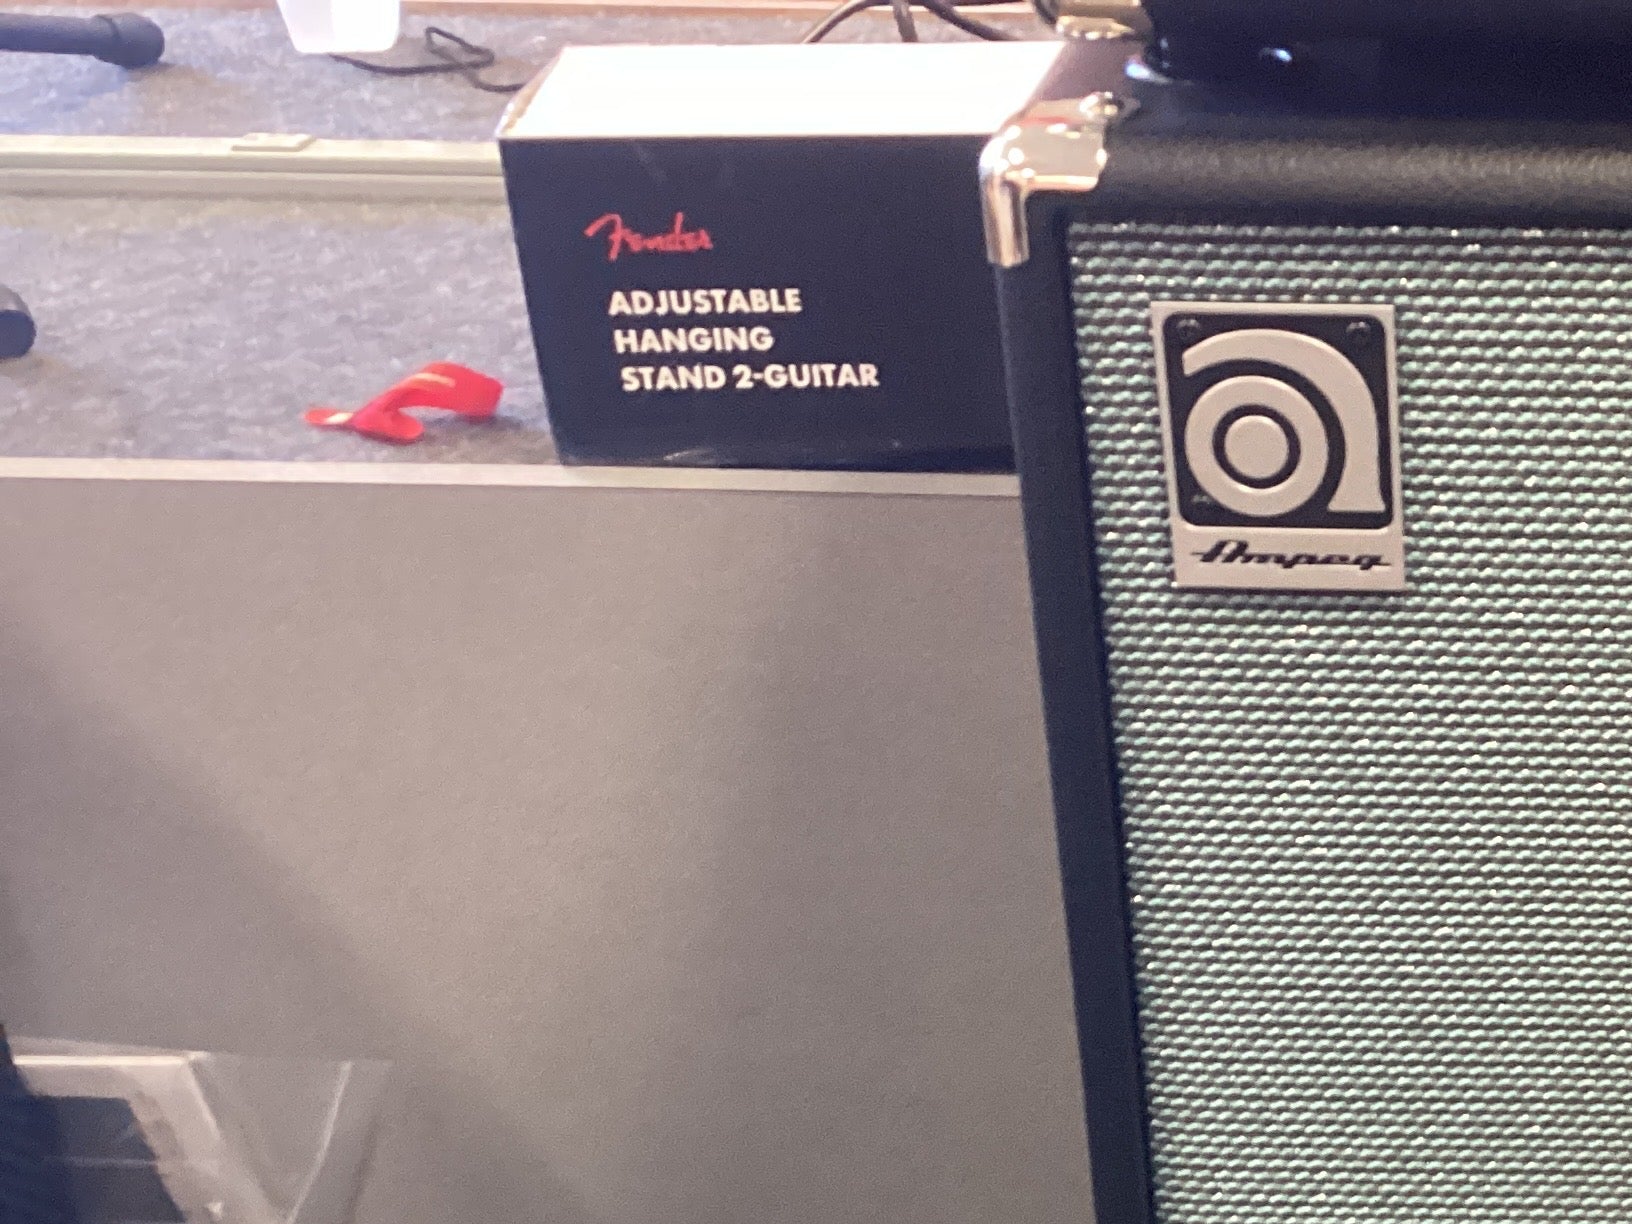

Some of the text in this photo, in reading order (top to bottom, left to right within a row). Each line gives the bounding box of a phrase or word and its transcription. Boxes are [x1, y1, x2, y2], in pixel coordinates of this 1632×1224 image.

[583, 212, 713, 261] Fender
[608, 288, 803, 317] ADJUSTABLE
[614, 326, 774, 353] HANGING
[621, 362, 880, 392] STAND 2-GUITAR
[1192, 539, 1392, 571] Ampeg
